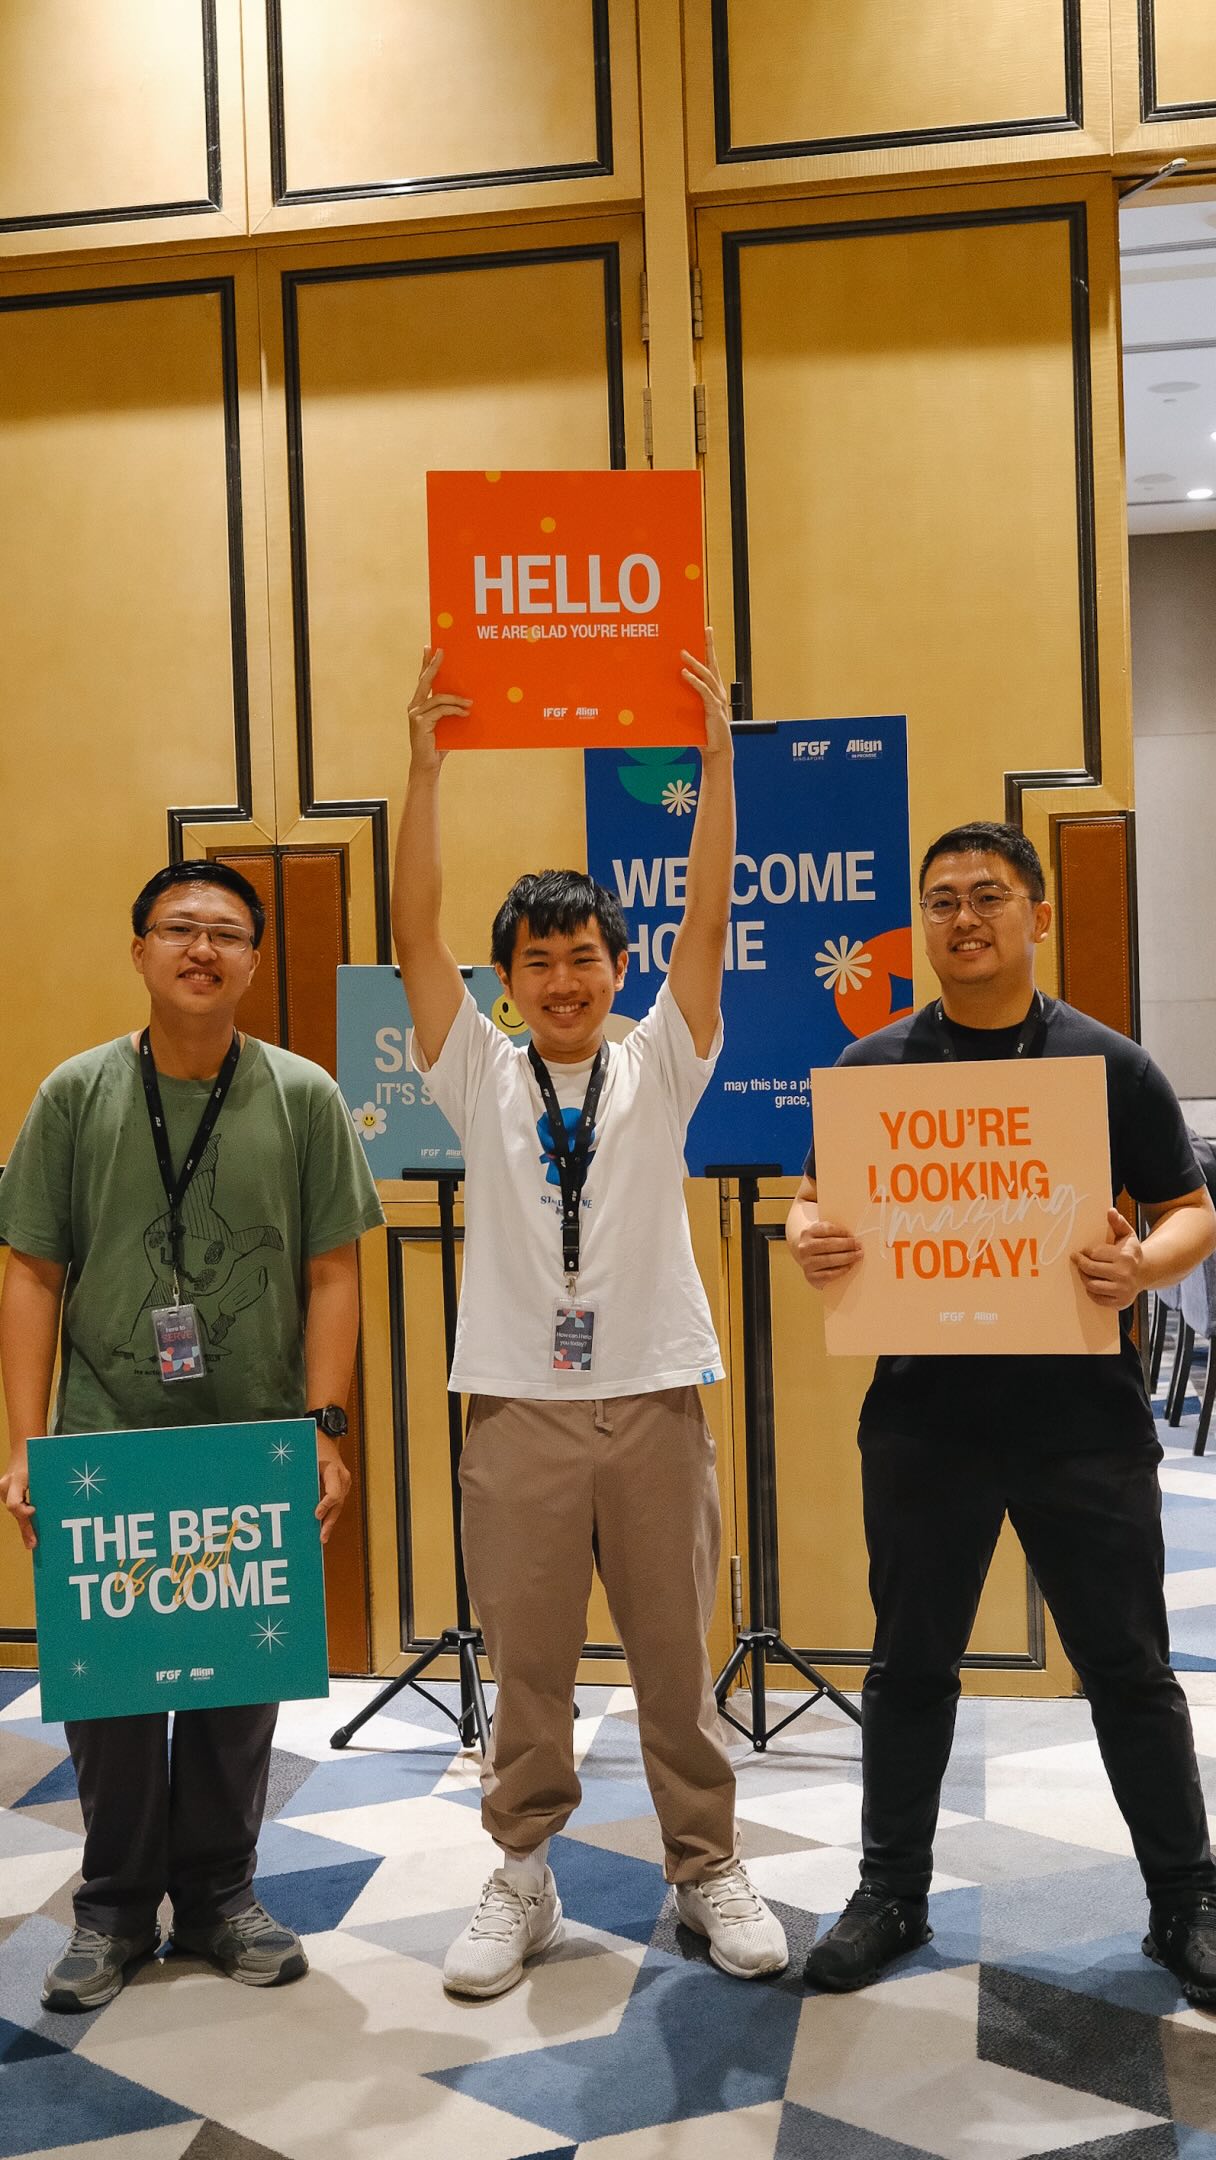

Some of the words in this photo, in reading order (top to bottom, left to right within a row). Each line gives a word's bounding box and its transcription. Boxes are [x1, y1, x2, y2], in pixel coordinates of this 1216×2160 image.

[474, 554, 660, 615] HELLO
[477, 625, 499, 639] WE
[502, 625, 528, 639] ARE
[531, 624, 567, 639] GLAD
[570, 624, 618, 638] YOU'RE
[621, 624, 659, 637] HERE!
[543, 707, 568, 718] IFGF
[792, 741, 831, 757] IFGF
[846, 739, 882, 753] Align
[612, 850, 876, 908] WECOME
[626, 921, 767, 974] HOE
[376, 1082, 416, 1105] IT'S
[724, 1081, 748, 1094] may
[750, 1078, 771, 1091] this
[773, 1079, 787, 1090] be
[790, 1080, 797, 1090] a
[775, 1095, 810, 1108] grace,
[879, 1106, 1032, 1150] YOU'RE
[421, 1148, 441, 1157] IFGF
[868, 1160, 1050, 1203] LOOKING
[854, 1180, 1091, 1267] Amazing
[886, 1238, 1040, 1279] TODAY!
[939, 1311, 966, 1322] IFGF
[61, 1512, 157, 1564] THE
[169, 1502, 291, 1556] BEST
[68, 1569, 136, 1620] TO
[148, 1559, 291, 1615] COME
[156, 1669, 182, 1681] IFGF
